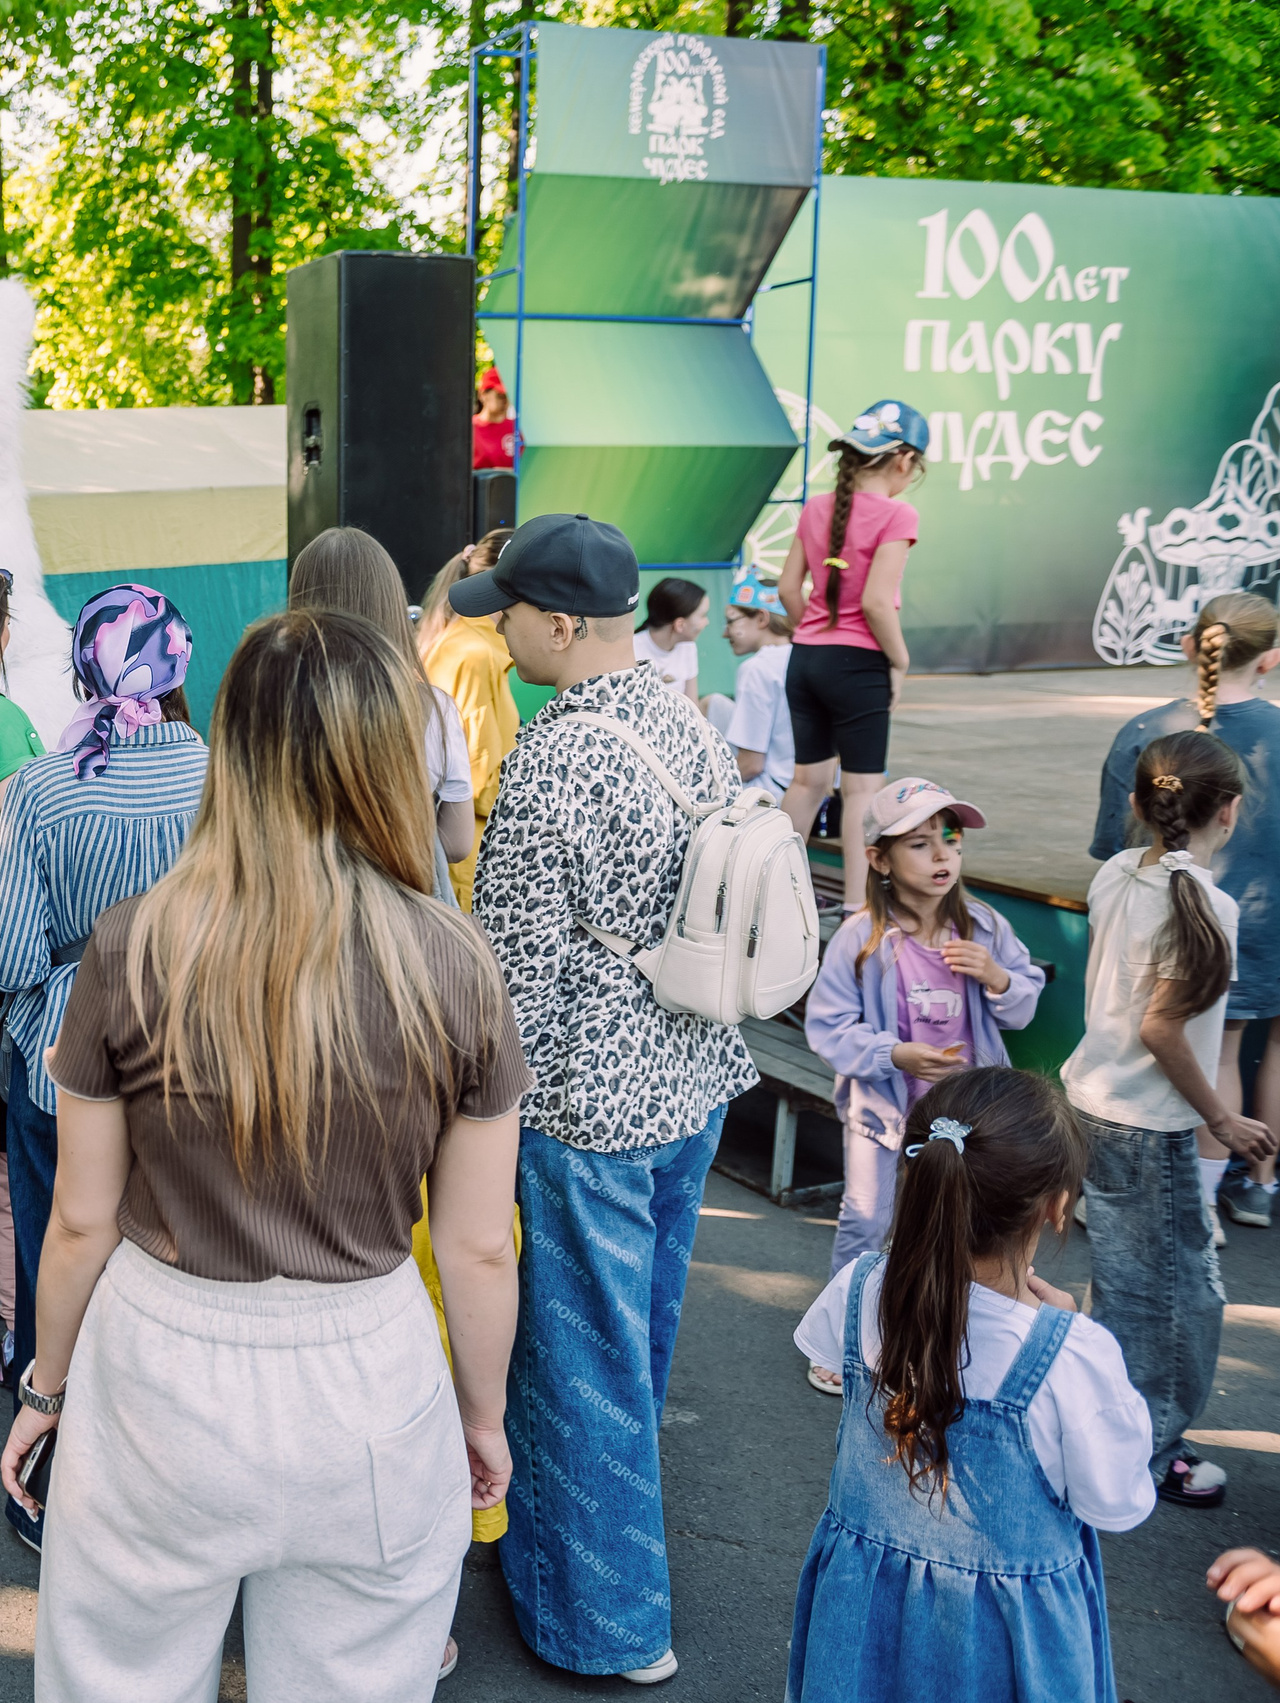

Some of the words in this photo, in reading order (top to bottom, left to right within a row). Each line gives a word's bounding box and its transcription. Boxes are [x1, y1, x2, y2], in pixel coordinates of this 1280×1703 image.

[656, 49, 690, 76] 100
[915, 208, 1055, 304] 100
[904, 319, 1123, 402] ПАРКУ
[546, 1298, 621, 1360] POROSUS
[569, 1375, 643, 1434] POROSUS
[598, 1452, 657, 1498] POROSUS
[554, 1523, 621, 1586] POROSUS
[575, 1599, 643, 1648] POROSUS
